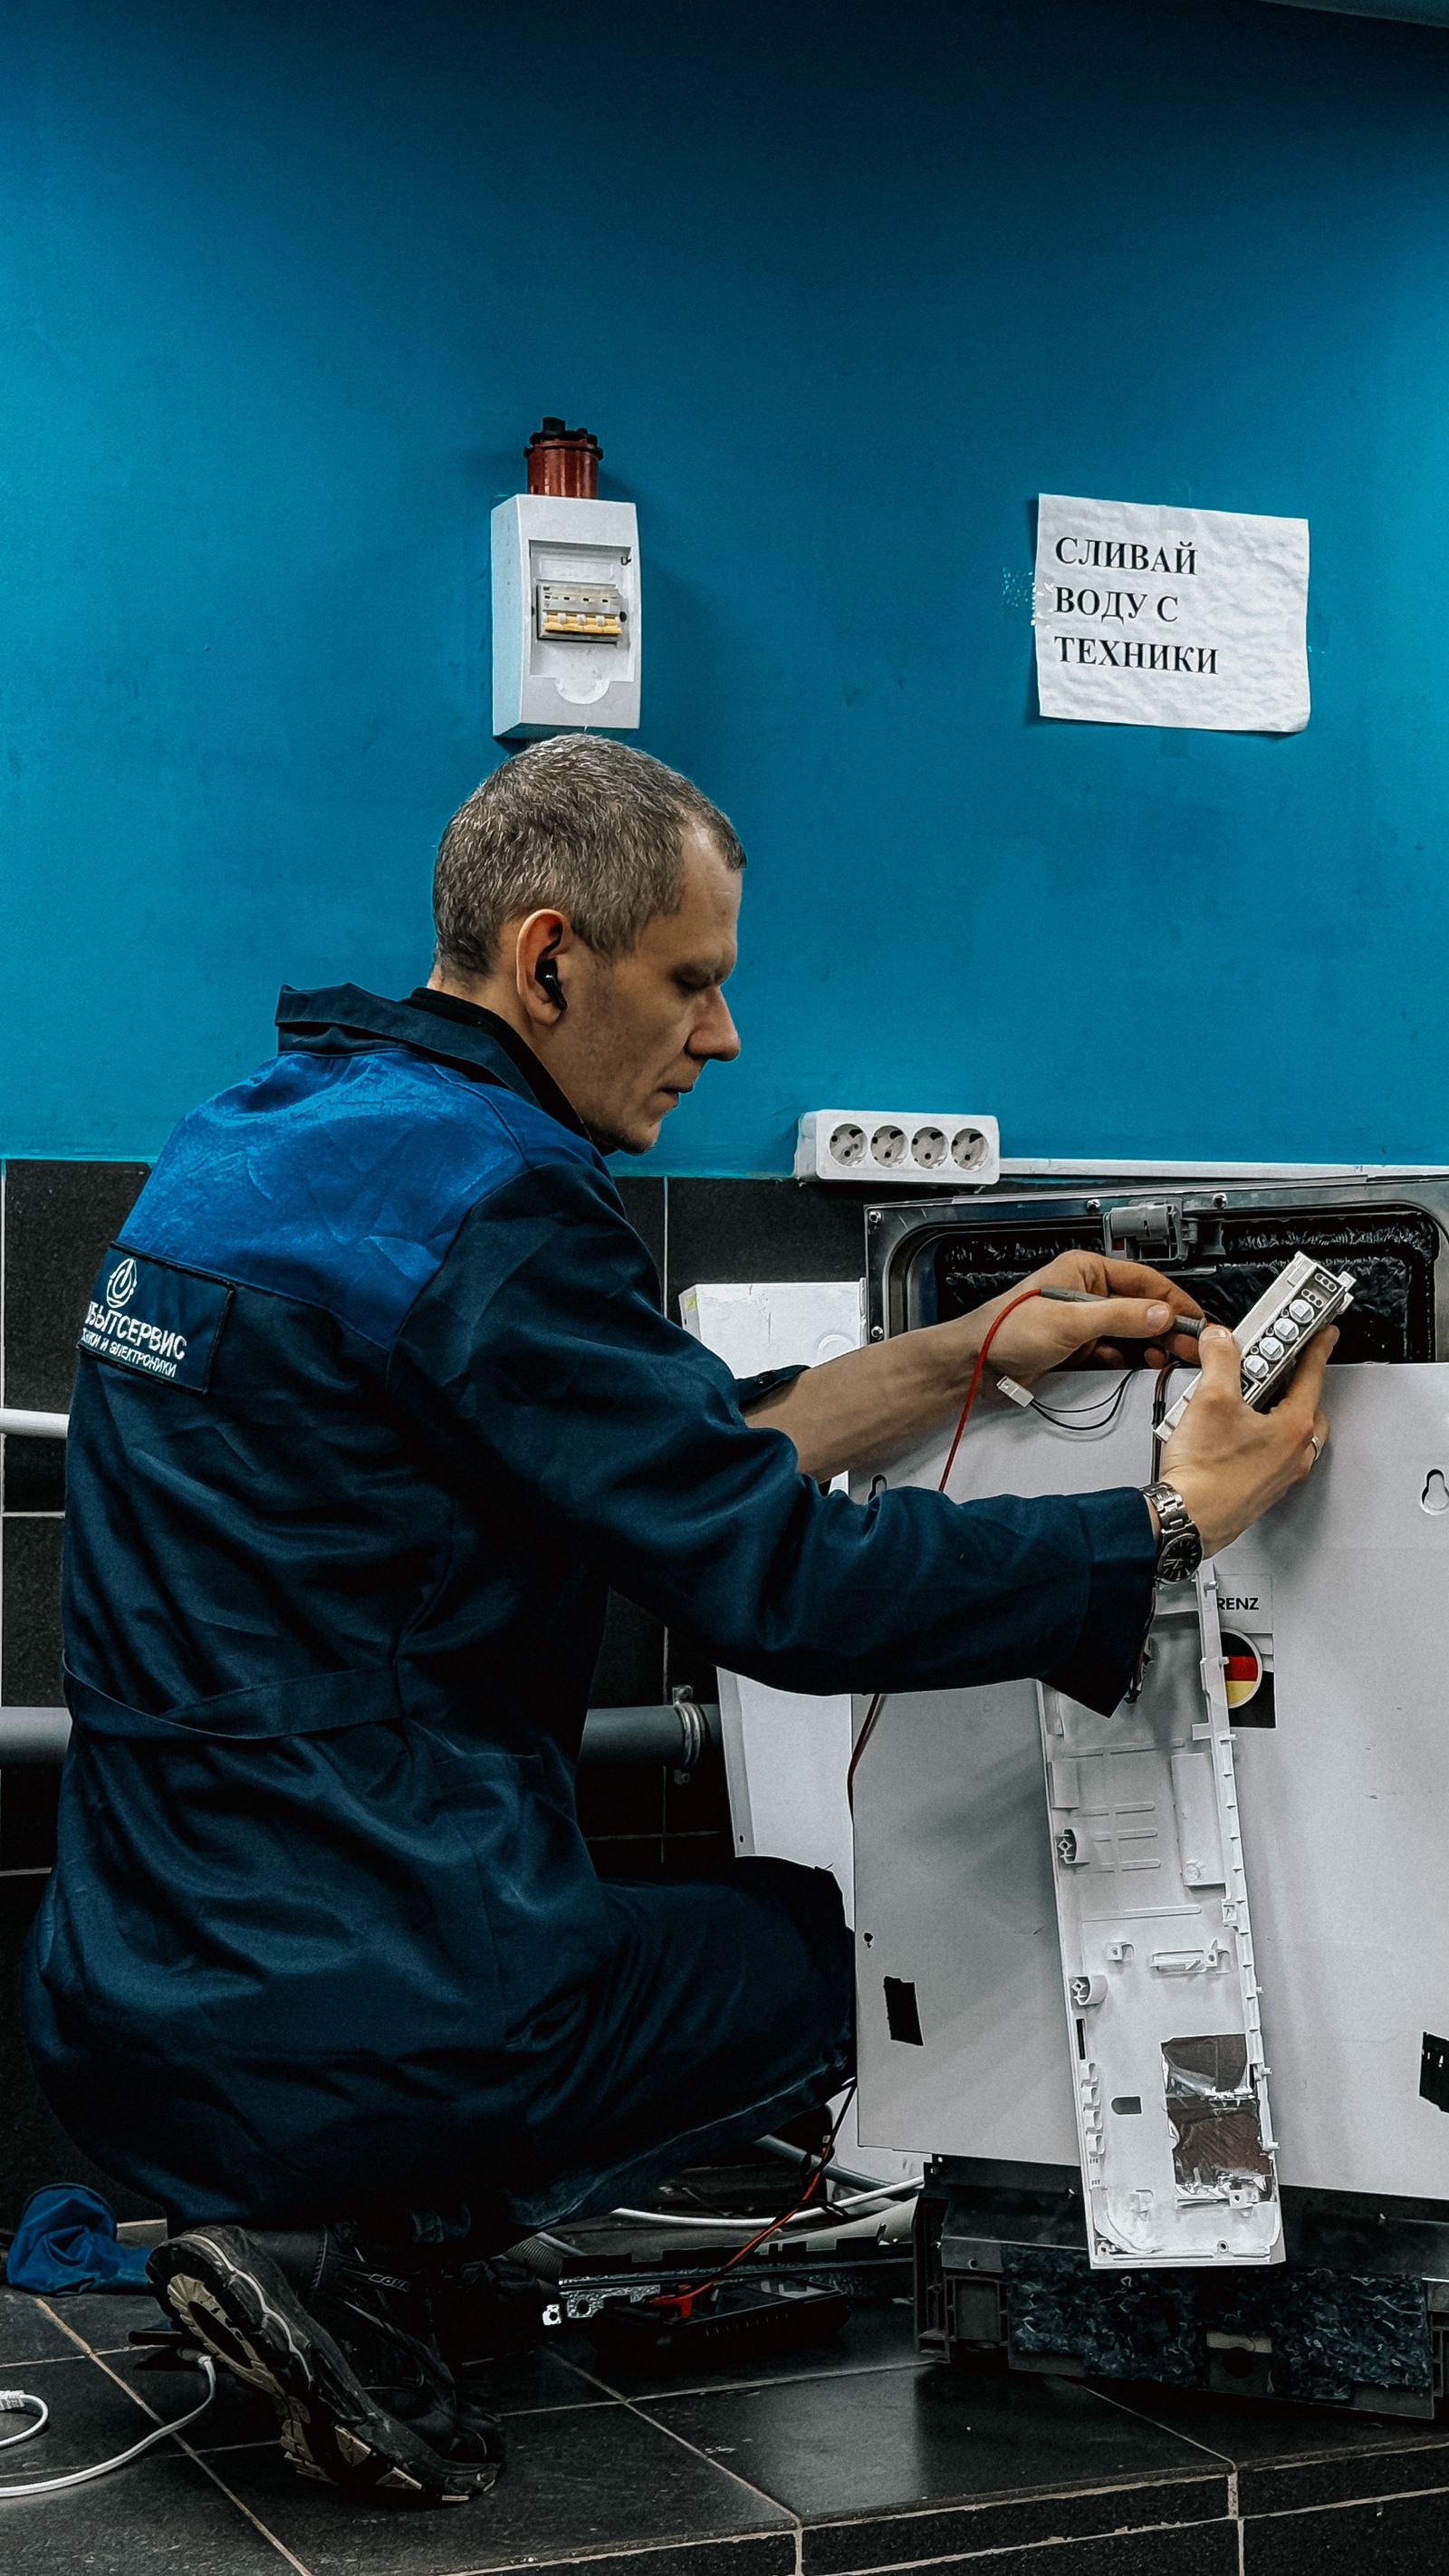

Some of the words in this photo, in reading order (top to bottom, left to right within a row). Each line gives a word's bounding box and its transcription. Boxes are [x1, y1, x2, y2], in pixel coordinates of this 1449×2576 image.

[1055, 536, 1198, 575] СЛИВАЙ
[1054, 586, 1147, 625] ВОДУ
[1156, 595, 1178, 622] С
[1054, 636, 1220, 675] ТЕХНИКИ
